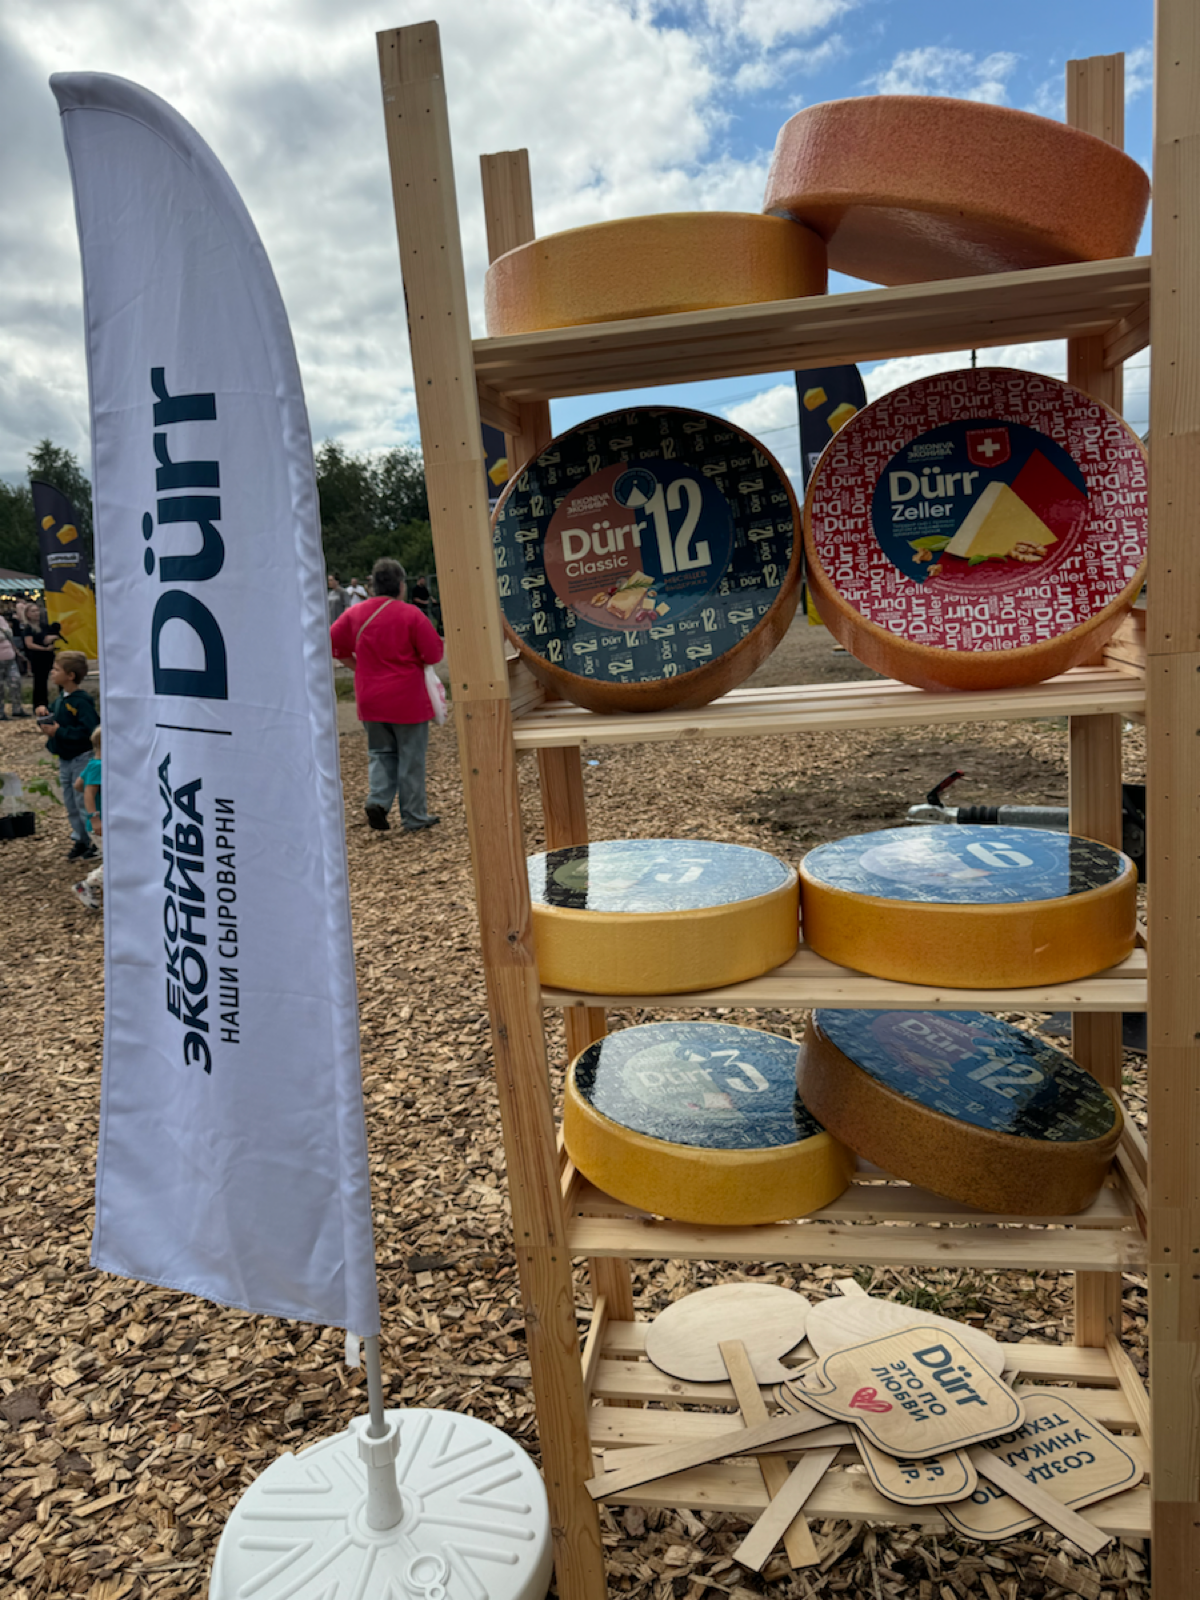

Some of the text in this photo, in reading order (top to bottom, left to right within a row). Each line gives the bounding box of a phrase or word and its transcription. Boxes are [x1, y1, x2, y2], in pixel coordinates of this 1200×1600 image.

[927, 396, 940, 421] Dürr
[951, 393, 992, 408] Dürr
[992, 382, 1005, 414] Zeller
[1008, 380, 1025, 411] Dürr
[1029, 400, 1061, 412] Dürr
[895, 412, 925, 426] Dürr
[953, 407, 993, 419] Zeller
[1051, 412, 1066, 438] Dürr
[1067, 406, 1099, 419] Dürr
[660, 418, 670, 435] Dürr
[682, 419, 707, 452] Dürr 12
[714, 432, 735, 443] Dürr
[863, 427, 904, 439] Zeller
[587, 435, 597, 451] Dürr
[609, 436, 633, 451] 12
[639, 437, 676, 460] Dürr 12
[850, 431, 862, 466] Zeller
[1084, 426, 1103, 460] Dürr
[538, 452, 560, 485] Dürr 12
[567, 466, 586, 476] Dürr
[701, 461, 728, 477] 12
[731, 457, 752, 468] Dürr
[864, 456, 879, 483] Dürr
[832, 474, 864, 487] Dürr
[889, 466, 980, 502] Dürr
[509, 506, 528, 517] Dürr
[529, 495, 545, 517] 12
[738, 479, 765, 513] Dürr 12
[852, 487, 866, 514] Dürr
[1103, 488, 1147, 506] Dürr
[824, 515, 865, 532] Dürr
[891, 502, 954, 521] Zeller
[142, 367, 229, 700] Dürr
[560, 520, 647, 562] Dürr
[644, 477, 712, 575] 12
[824, 532, 866, 545] Zeller
[1119, 518, 1140, 556] Dürr
[515, 528, 538, 561] Dürr 12
[747, 526, 774, 561] Dürr 12
[565, 555, 629, 577] Classic
[836, 545, 853, 580] Dürr
[855, 542, 869, 579] Zeller
[1083, 542, 1099, 580] Zeller
[1100, 540, 1120, 578] Dürr
[497, 574, 511, 597] 12
[740, 563, 780, 588] Dürr 12
[870, 568, 885, 597] Dürr
[520, 574, 545, 609] Dürr 12
[872, 598, 906, 611] Dürr
[1015, 585, 1052, 600] Dürr
[1053, 584, 1075, 624] Dürr
[1075, 582, 1091, 621] Zeller
[532, 611, 548, 635] 12
[679, 607, 718, 632] Dürr 12
[727, 607, 755, 625] 12
[908, 597, 928, 634] Dürr
[930, 595, 943, 633] Zeller
[944, 604, 990, 621] Dürr
[601, 635, 622, 646] Dürr
[649, 623, 676, 660] Dürr 12
[971, 620, 1017, 638] Dürr
[547, 638, 563, 663] 12
[572, 639, 598, 675] Dürr 12
[686, 643, 713, 660] 12
[972, 638, 1019, 652] Zeller
[608, 659, 634, 675] 12
[966, 841, 1033, 868] 6
[157, 751, 182, 1021] EKONIVA
[173, 776, 212, 1075] ЭКОНИВА
[214, 797, 240, 1044] НАШИ СЫРОВАРНИ
[899, 1018, 981, 1060] Dürr
[636, 1068, 713, 1087] Dürr
[711, 1049, 770, 1093] 3
[966, 1046, 1045, 1099] 12
[889, 1359, 948, 1416] ЭТО ПО
[912, 1343, 988, 1406] Dürr
[871, 1366, 931, 1422] ЛЮБВИ
[980, 1413, 1069, 1450] ТЕХНОЛ
[998, 1428, 1092, 1467] УНИКАЛ
[1025, 1451, 1096, 1484] СОЗДА
